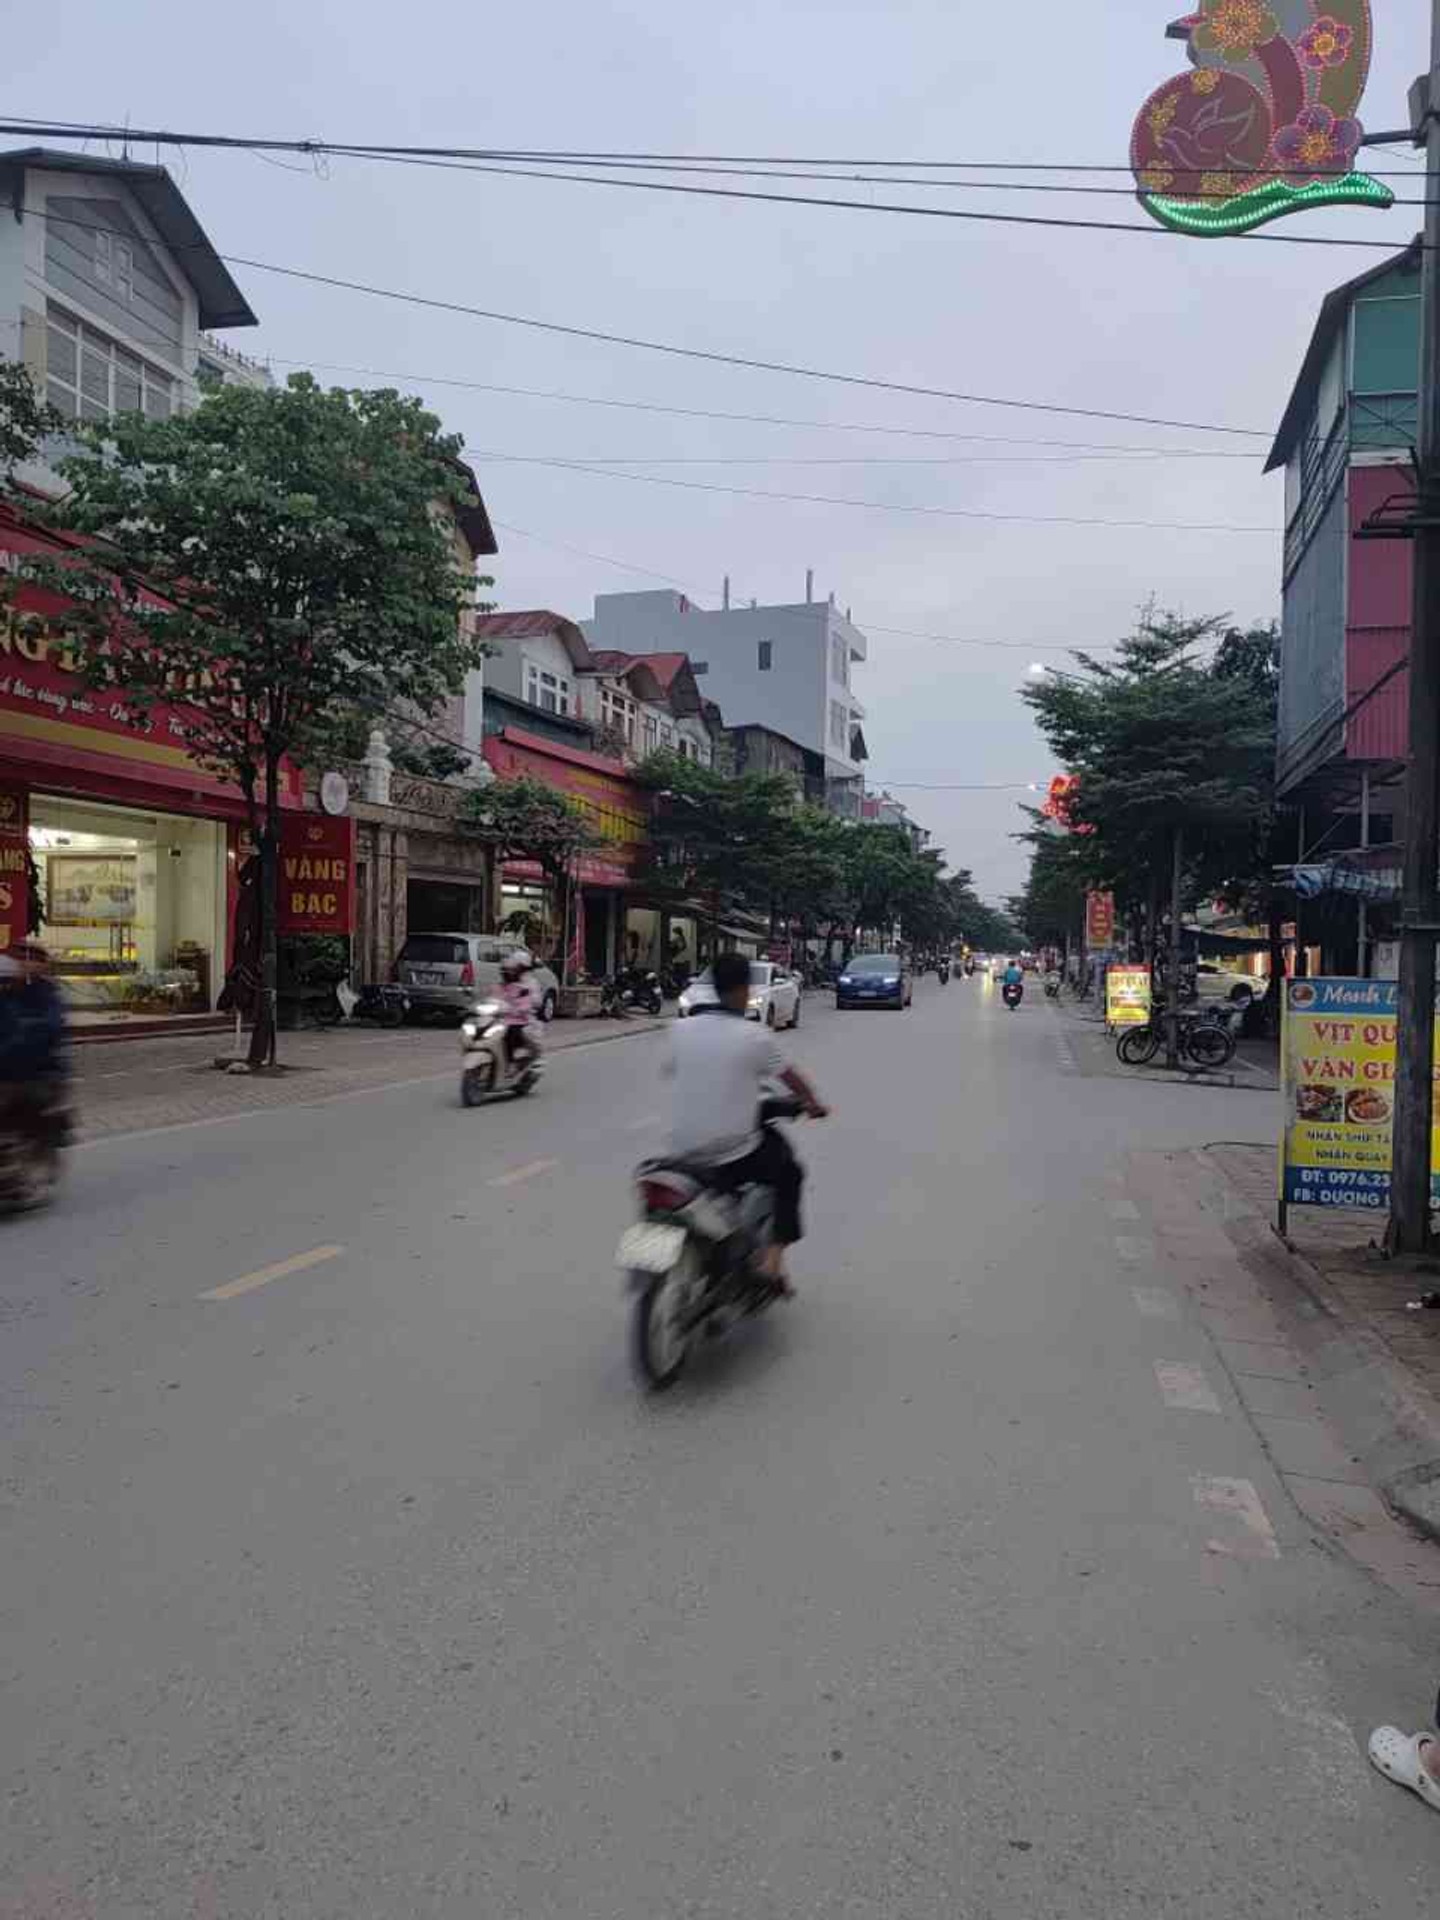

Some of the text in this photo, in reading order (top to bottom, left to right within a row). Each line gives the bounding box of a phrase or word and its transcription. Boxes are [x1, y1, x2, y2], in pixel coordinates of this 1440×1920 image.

[284, 853, 347, 881] VÀNG
[291, 892, 338, 919] BẠC
[1362, 1023, 1398, 1046] QU
[1328, 1172, 1393, 1187] 0976.23
